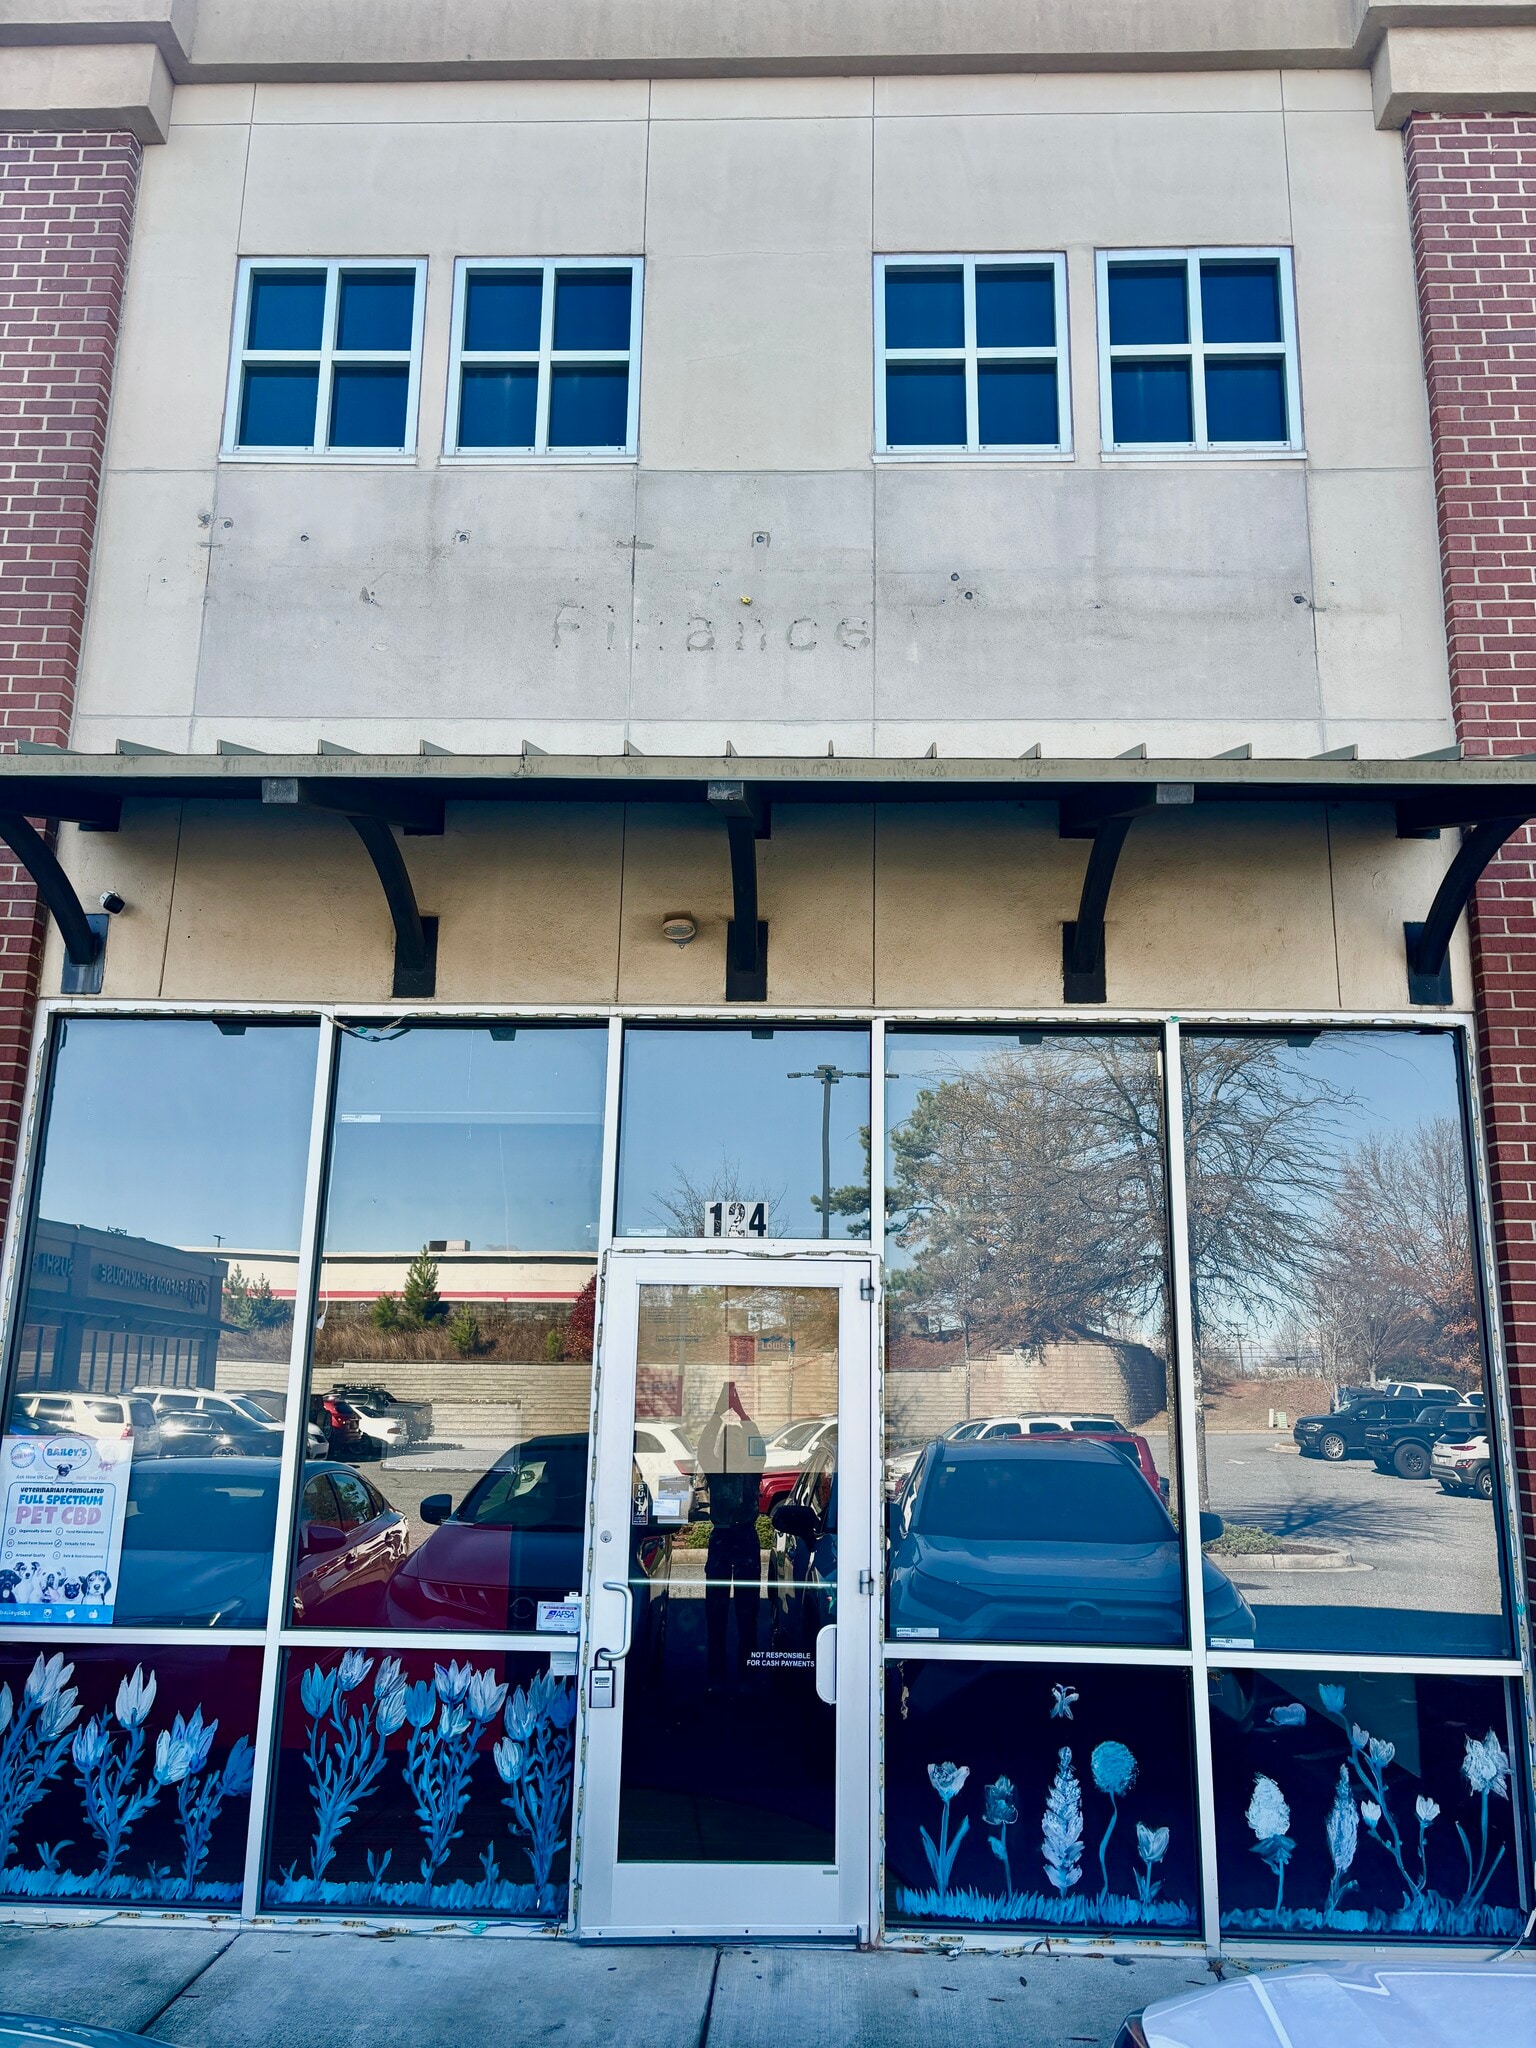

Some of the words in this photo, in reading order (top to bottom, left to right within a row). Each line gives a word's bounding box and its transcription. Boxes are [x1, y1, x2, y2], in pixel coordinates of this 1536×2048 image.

[553, 602, 871, 652] Fiance
[709, 1202, 767, 1237] 124
[46, 1448, 88, 1457] BAILEY'S
[18, 1494, 44, 1505] FULL
[46, 1494, 104, 1506] SPECTRUM
[15, 1505, 58, 1525] PET
[61, 1506, 102, 1526] CBD
[555, 1610, 575, 1619] AFSA
[765, 1651, 811, 1659] RESPONSIBLE
[780, 1660, 815, 1668] PAYMENTS
